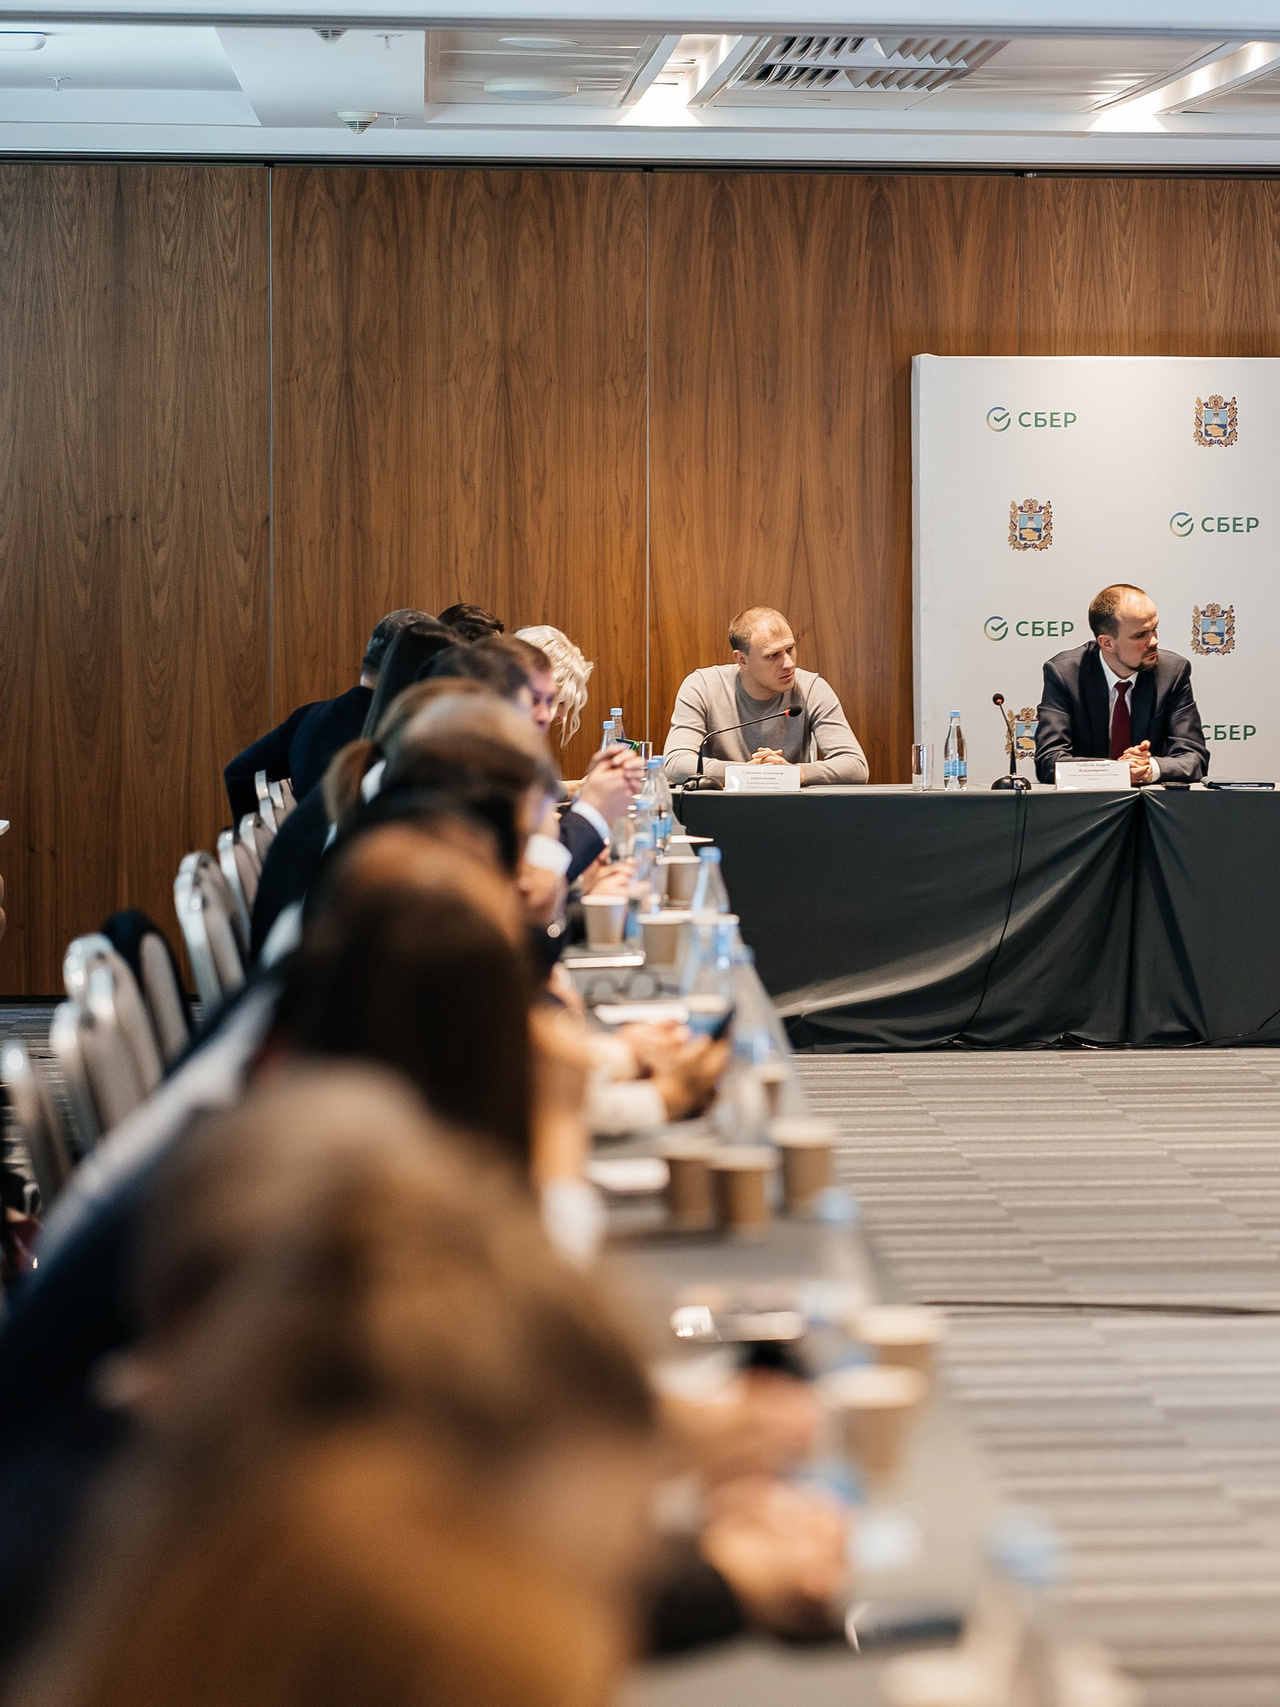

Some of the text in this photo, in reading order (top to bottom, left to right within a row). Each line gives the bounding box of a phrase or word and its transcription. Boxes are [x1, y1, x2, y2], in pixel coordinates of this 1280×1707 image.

[1018, 411, 1077, 428] СБЕР
[1201, 516, 1260, 533] СБЕР
[1016, 620, 1075, 637] СБЕР
